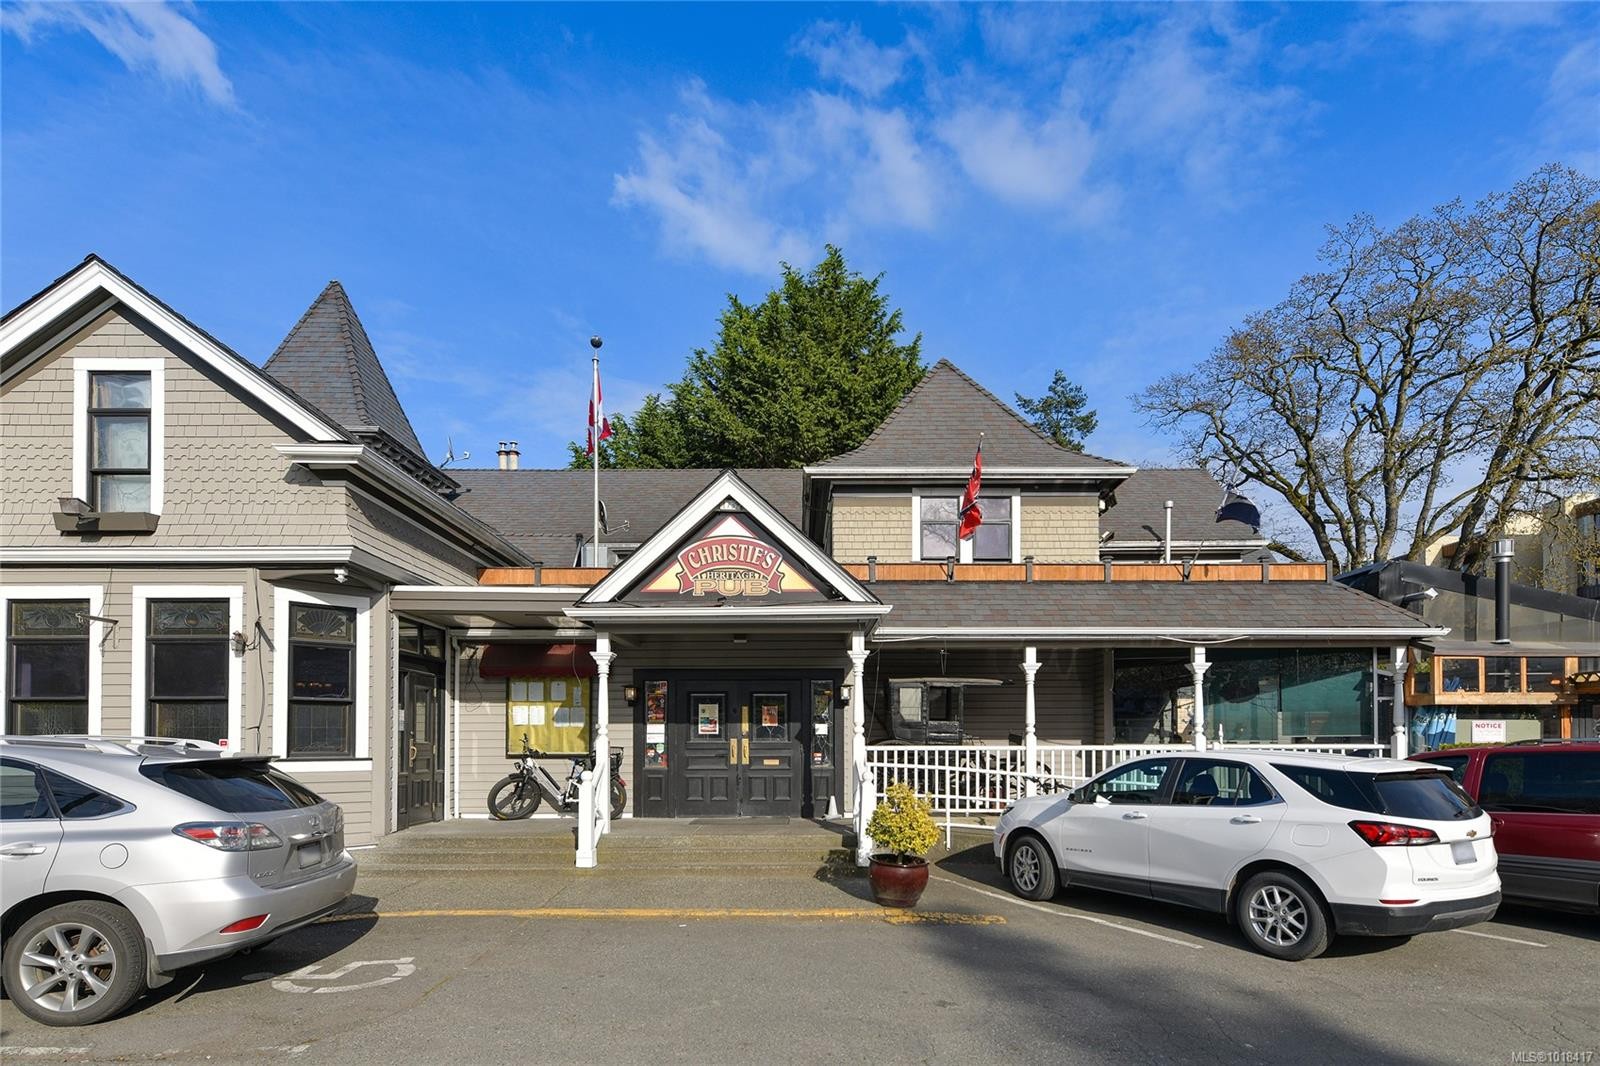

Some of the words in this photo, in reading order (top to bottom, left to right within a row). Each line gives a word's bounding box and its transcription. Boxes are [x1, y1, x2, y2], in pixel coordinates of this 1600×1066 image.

[687, 543, 776, 569] CHRISTIE'S
[706, 571, 756, 580] HERITAGE
[693, 579, 770, 596] PUB
